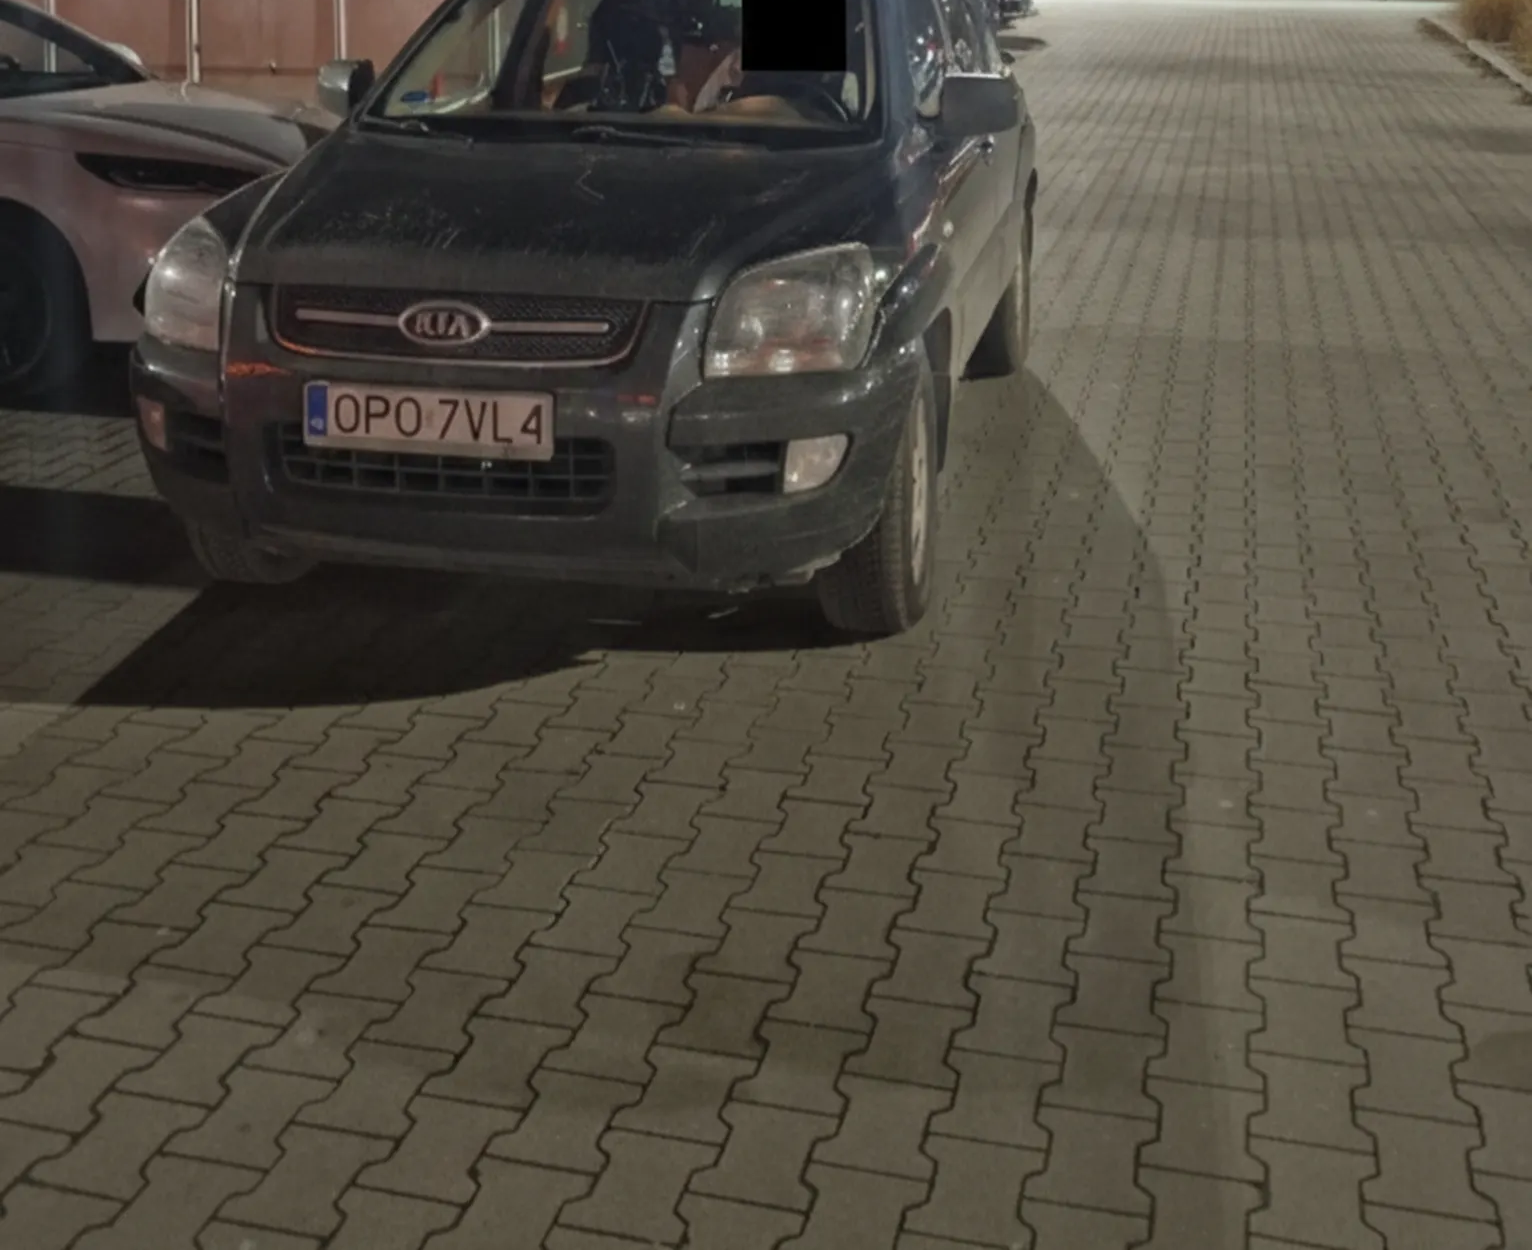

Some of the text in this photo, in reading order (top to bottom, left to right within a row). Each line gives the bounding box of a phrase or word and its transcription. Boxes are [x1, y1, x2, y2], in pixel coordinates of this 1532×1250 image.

[414, 311, 470, 339] KIA
[334, 393, 543, 445] OPO 7VL4
